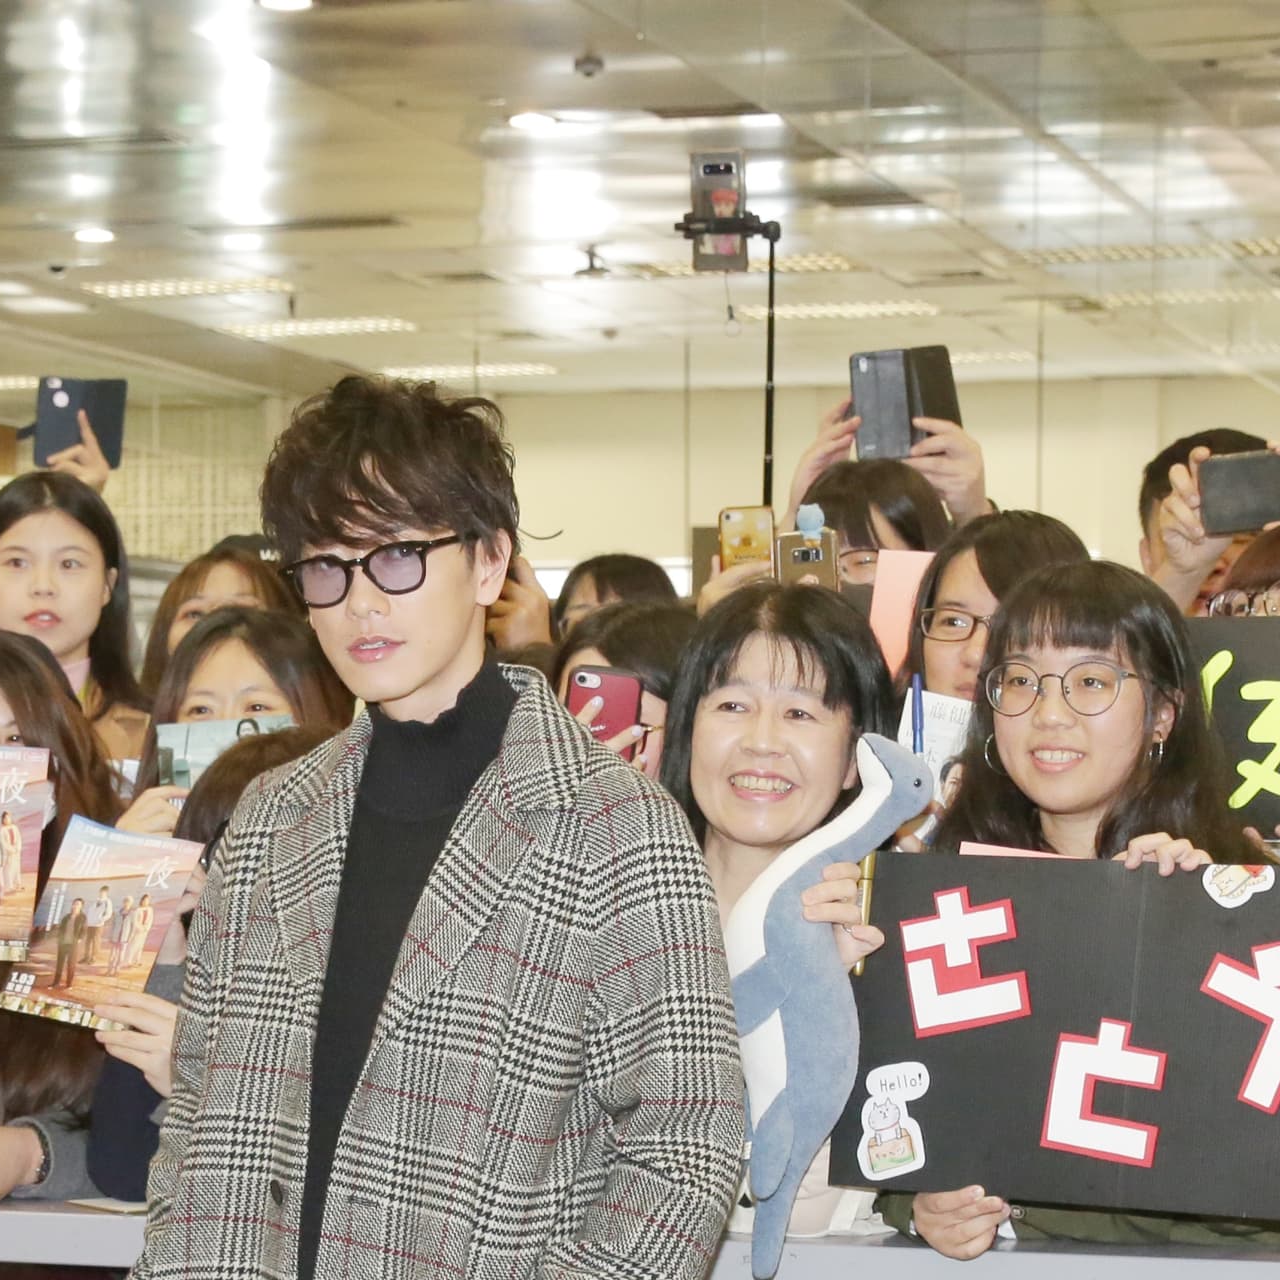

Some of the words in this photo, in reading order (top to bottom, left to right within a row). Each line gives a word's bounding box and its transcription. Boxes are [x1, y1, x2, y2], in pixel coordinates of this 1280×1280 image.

[71, 842, 179, 889] 那一夜
[11, 971, 37, 986] 1.03
[879, 1072, 923, 1093] Hello!
